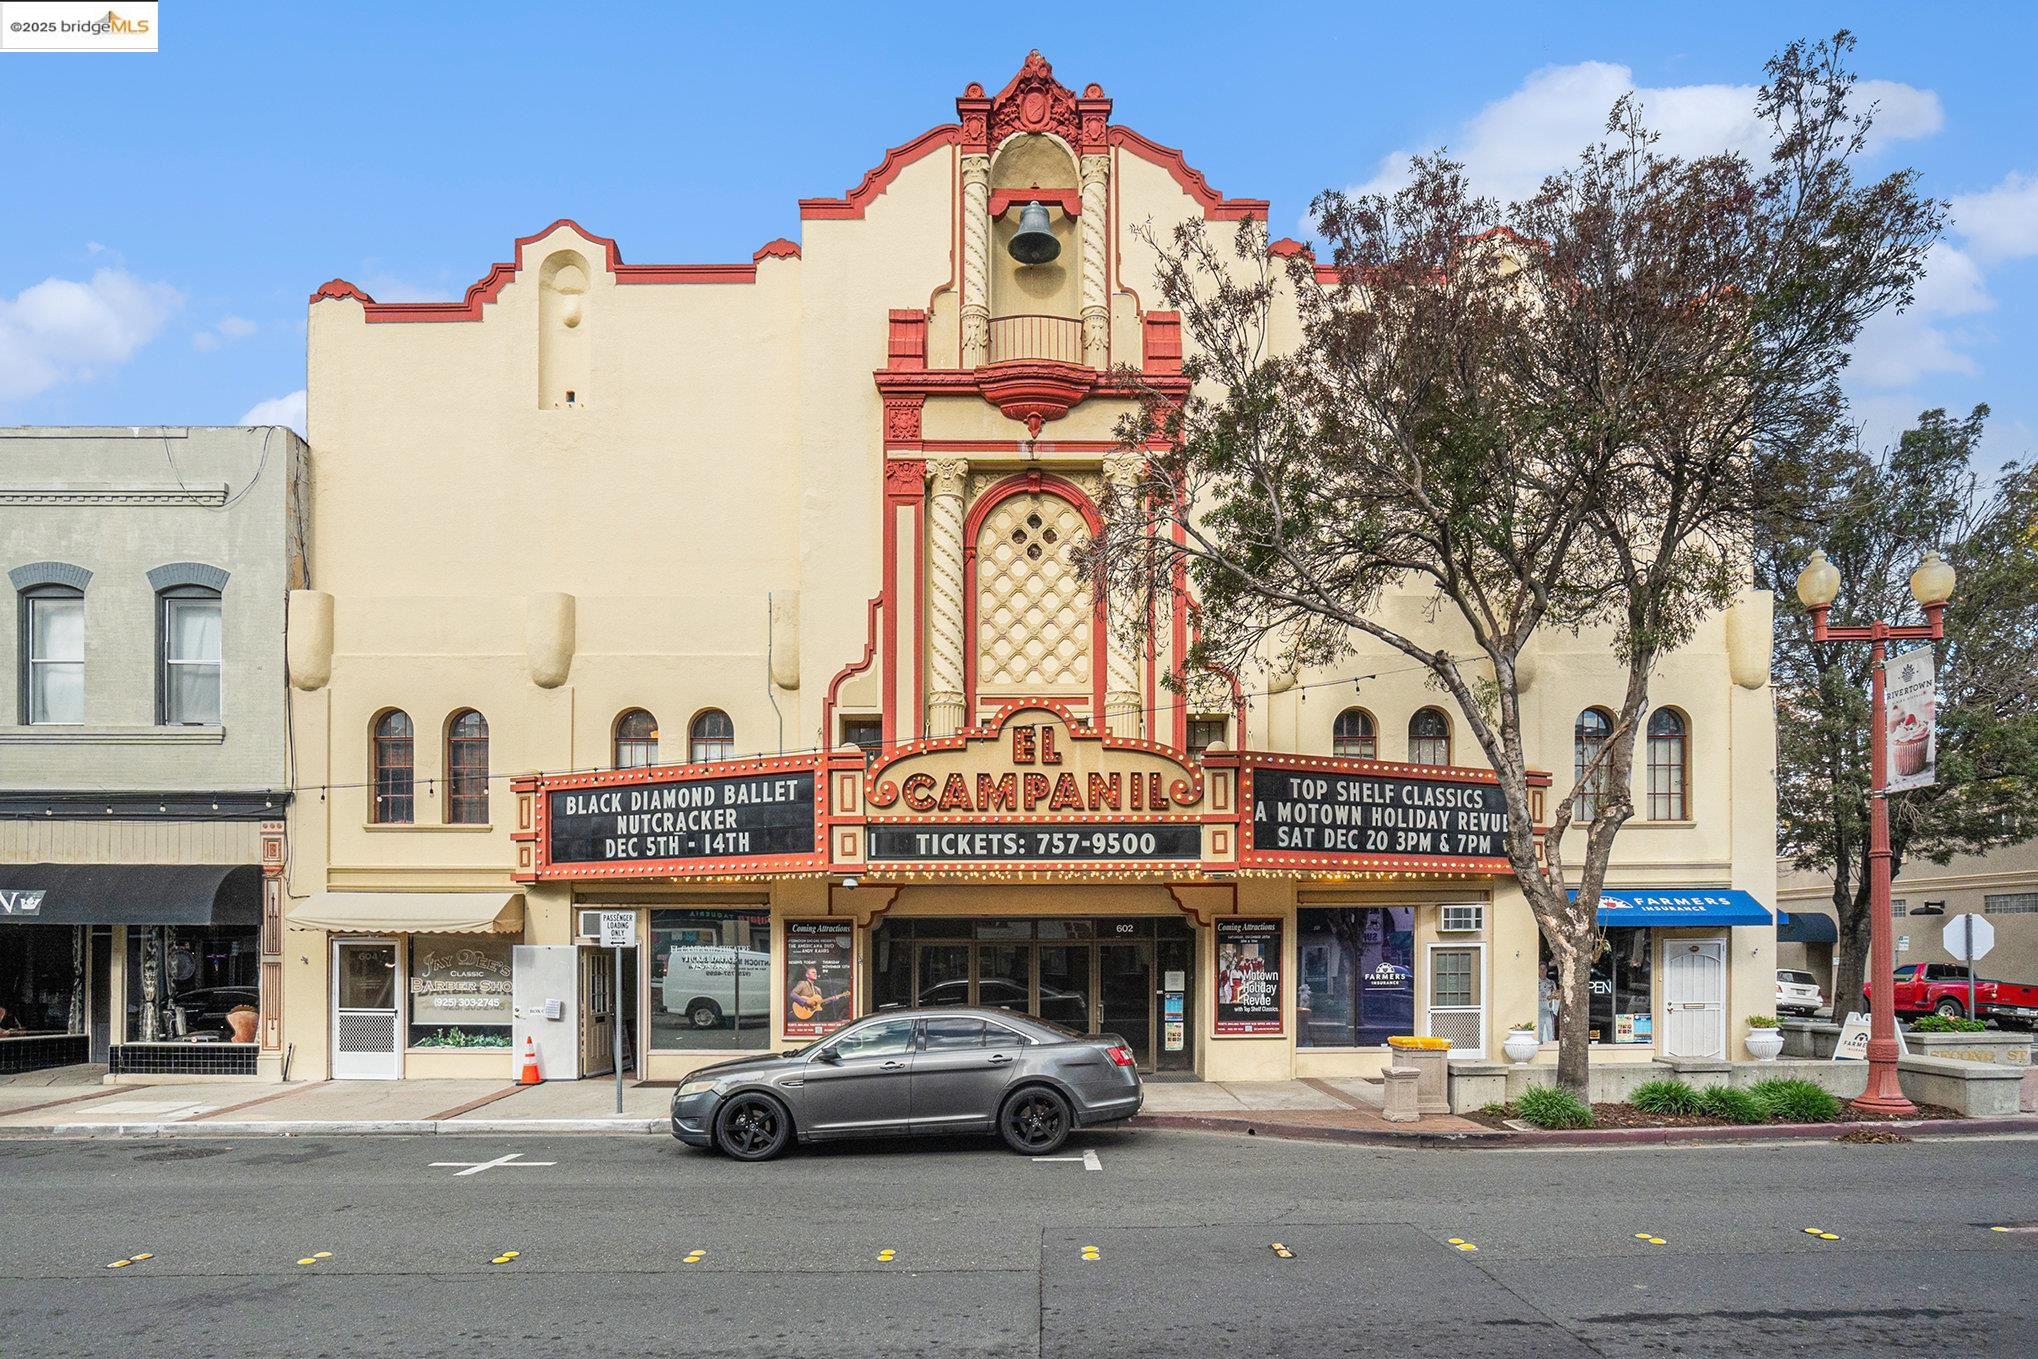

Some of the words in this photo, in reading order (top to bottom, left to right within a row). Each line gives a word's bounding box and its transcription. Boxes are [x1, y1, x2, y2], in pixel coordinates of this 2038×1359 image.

[1886, 679, 1933, 700] RIVERTOWN
[1013, 725, 1063, 764] EL
[566, 792, 622, 815] BLACK
[631, 786, 716, 811] DIAMOND
[724, 780, 798, 805] BALLET
[902, 772, 1170, 811] CAMPANIL
[1289, 777, 1328, 800] TOP
[1336, 780, 1395, 804] SHELF
[1402, 785, 1483, 809] CLASSICS
[617, 808, 738, 835] NUTCRACKER
[1254, 800, 1268, 822] A
[1277, 801, 1362, 826] MOTOWN
[1371, 806, 1451, 830] HOLIDAY
[605, 837, 639, 859] DEC
[646, 835, 680, 857] 5TH
[704, 832, 750, 854] 14TH
[916, 833, 1026, 855] TICKETS:
[1036, 832, 1156, 855] 757-9500
[1278, 826, 1316, 848] SAT
[1324, 828, 1359, 850] DEC
[1366, 829, 1389, 851] 20
[1395, 831, 1432, 853] 3PM
[1439, 833, 1450, 853] &
[1457, 834, 1491, 854] 7PM
[1633, 897, 1731, 906] FARMERS
[792, 923, 816, 934] Coming
[1116, 924, 1134, 933] 602
[1218, 922, 1241, 933] Coming
[422, 951, 453, 977] JAY
[410, 977, 477, 994] BARBER
[479, 979, 514, 993] SHO
[1588, 981, 1612, 994] PEN
[433, 997, 458, 1008] (925)
[458, 997, 501, 1008] 303-2745
[1842, 1040, 1867, 1049] FARME
[2006, 1050, 2029, 1061] ST
